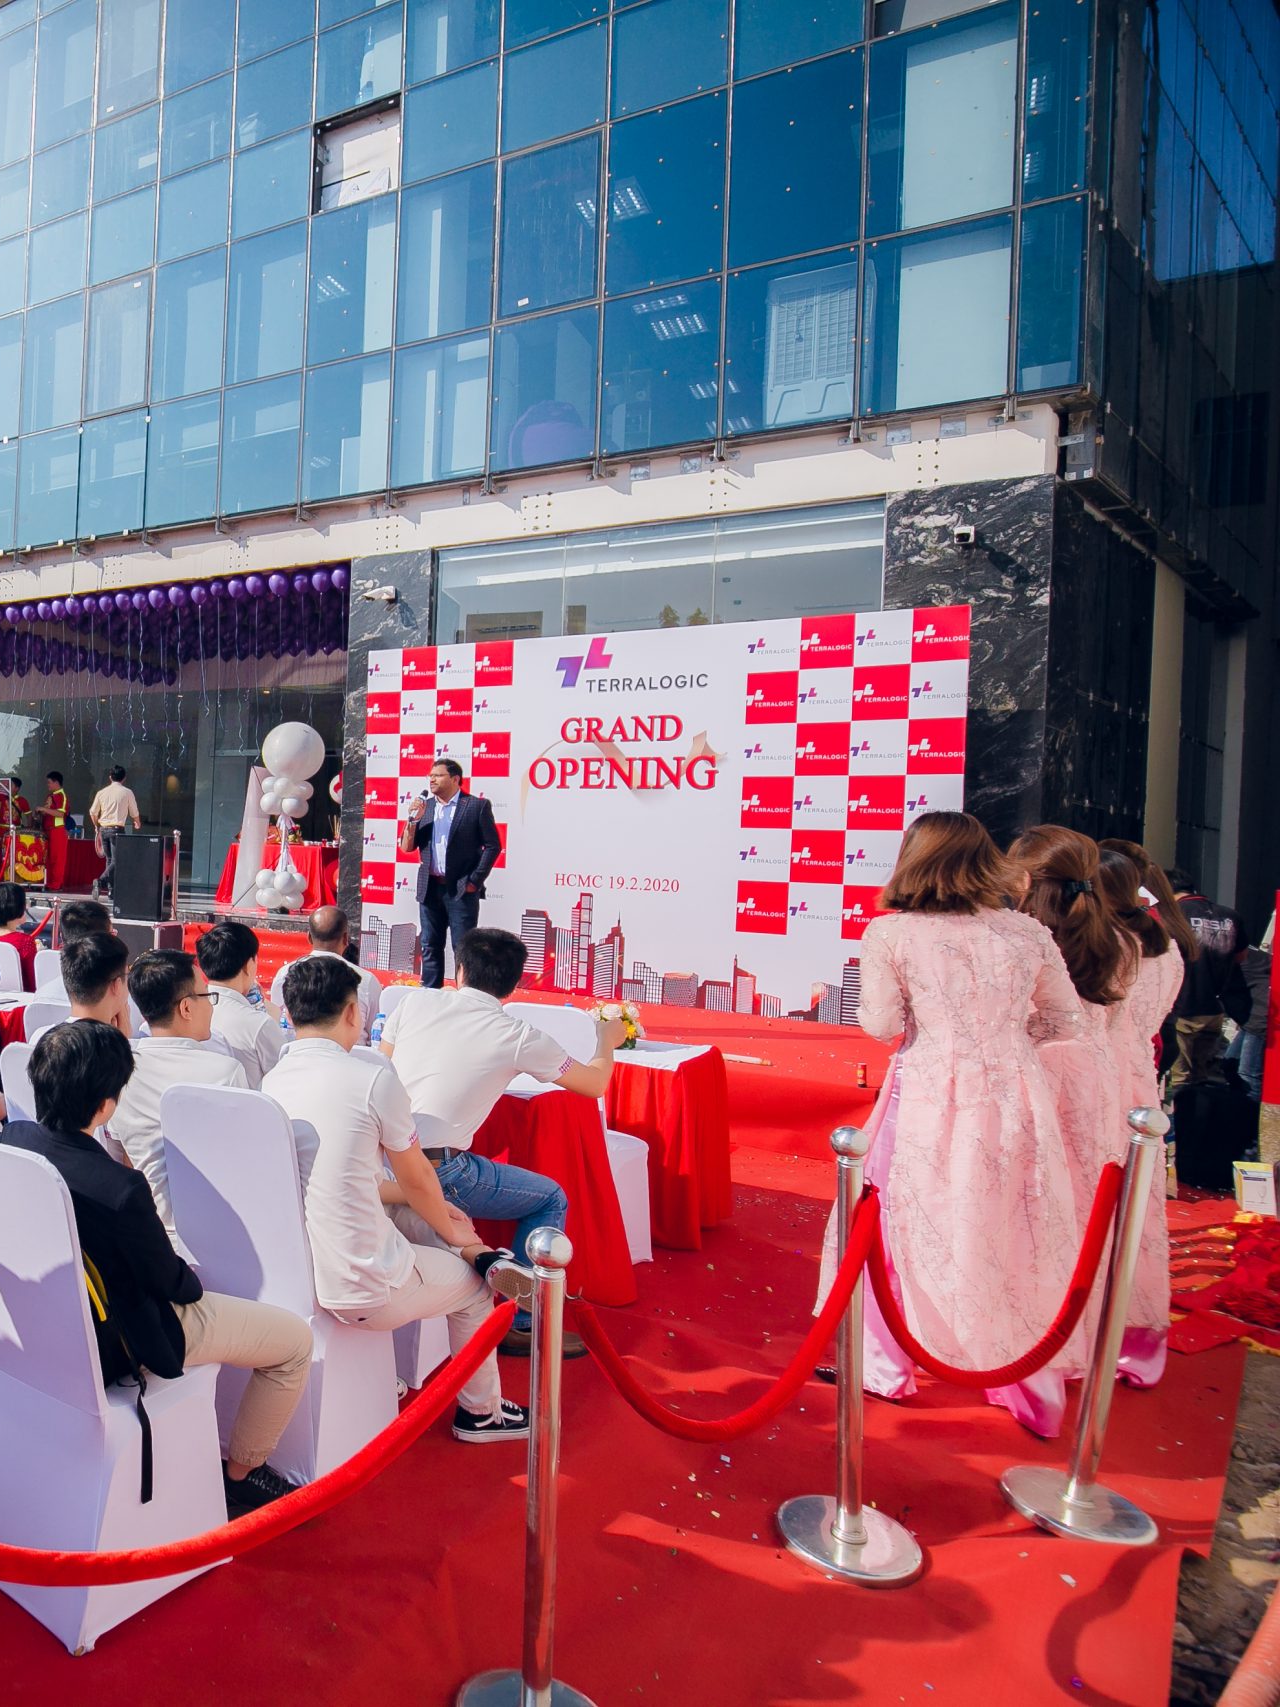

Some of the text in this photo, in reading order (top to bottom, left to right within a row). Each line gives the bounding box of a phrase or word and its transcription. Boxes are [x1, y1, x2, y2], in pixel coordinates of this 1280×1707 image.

[811, 644, 852, 652] TERRALOGIC
[866, 640, 910, 648] TERRALOGIC
[757, 647, 797, 655] TERRALOGIC
[586, 673, 709, 693] TERRALOGIC
[863, 695, 908, 703] TERRALOGIC
[754, 700, 795, 708] TERRALOGIC
[561, 714, 684, 744] GRAND
[860, 752, 905, 760] TERRALOGIC
[919, 751, 966, 759] TERRALOGIC
[528, 755, 720, 790] OPENING
[554, 873, 680, 893] HCMC 19.2.2020
[746, 910, 786, 918] TERRALOGIC
[798, 914, 841, 922] TERRALOGIC
